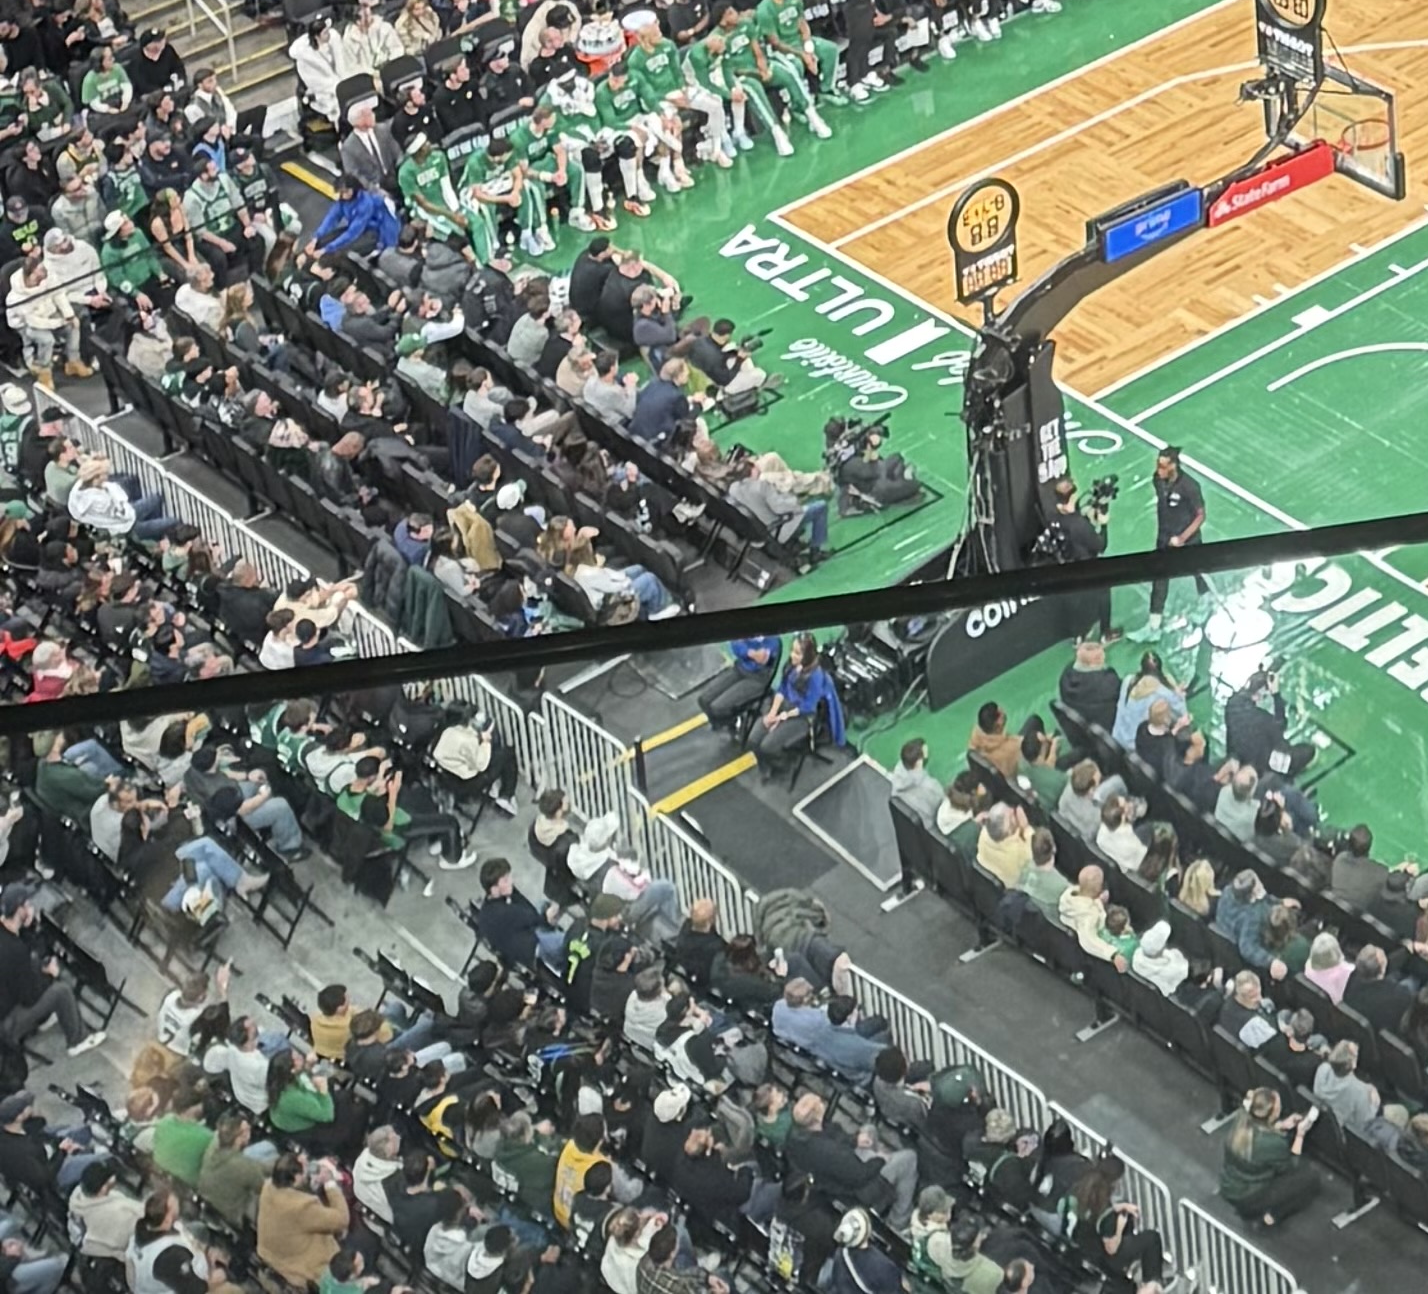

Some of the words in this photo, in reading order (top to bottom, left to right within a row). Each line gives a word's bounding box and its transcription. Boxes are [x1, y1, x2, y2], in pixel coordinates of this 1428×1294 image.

[1231, 185, 1261, 210] State
[1261, 174, 1291, 200] Farm
[718, 223, 897, 337] ULTRA
[779, 337, 910, 412] Courtside
